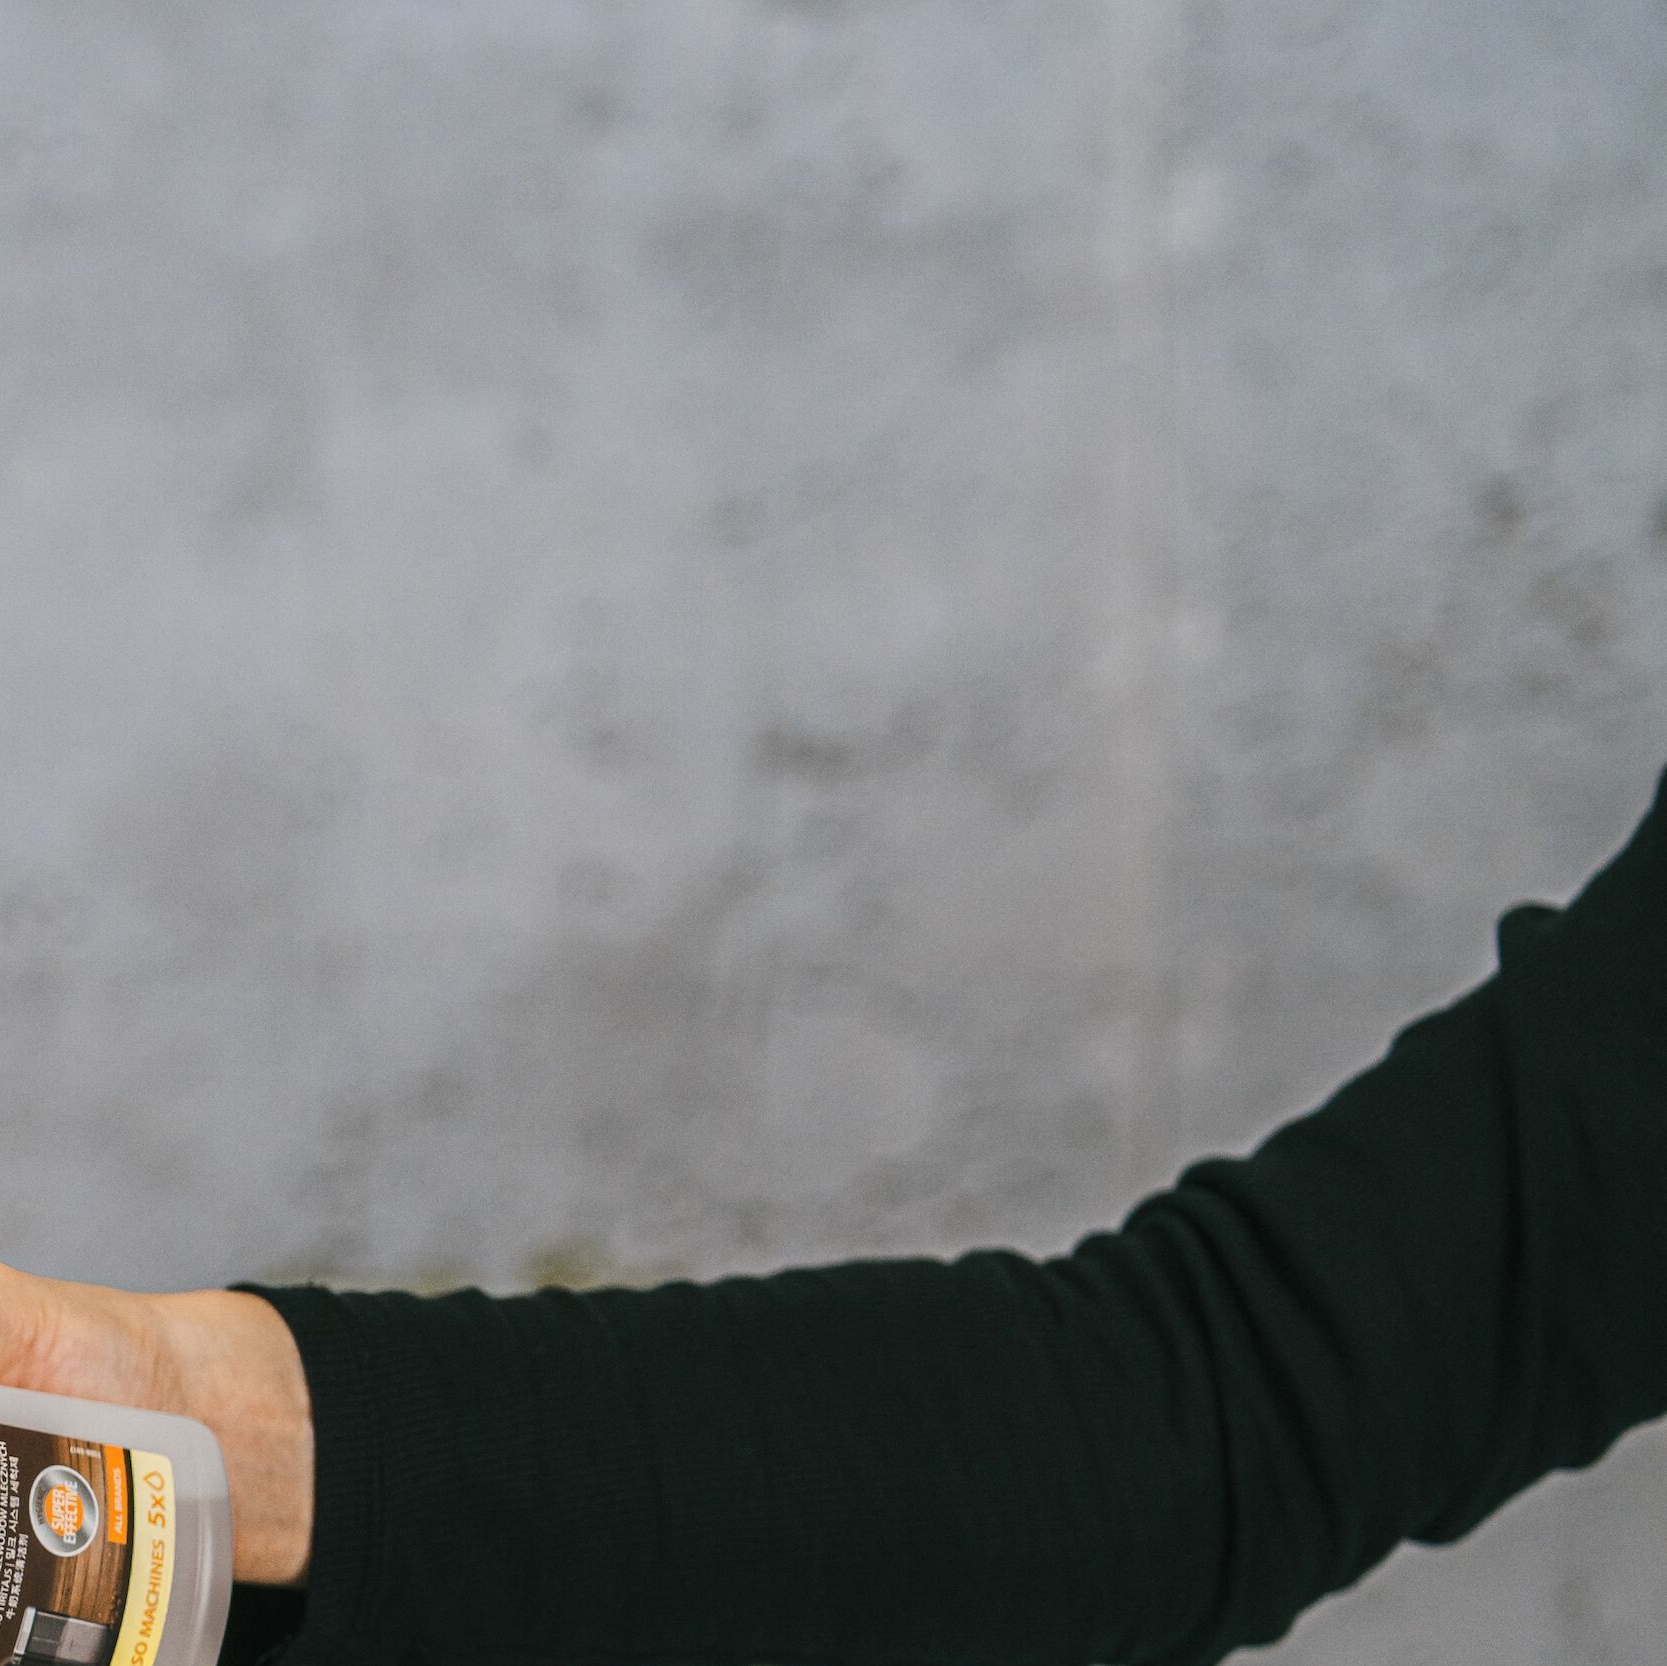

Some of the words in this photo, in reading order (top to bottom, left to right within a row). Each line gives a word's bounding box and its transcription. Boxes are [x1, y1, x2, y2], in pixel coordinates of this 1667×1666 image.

[0, 1441, 8, 1506] MLECZNYCH
[52, 1489, 64, 1531] SUPER
[63, 1481, 78, 1544] EFFECTIVE
[114, 1515, 123, 1534] ALL
[147, 1494, 166, 1529] 5x
[141, 1541, 165, 1638] MACHINES
